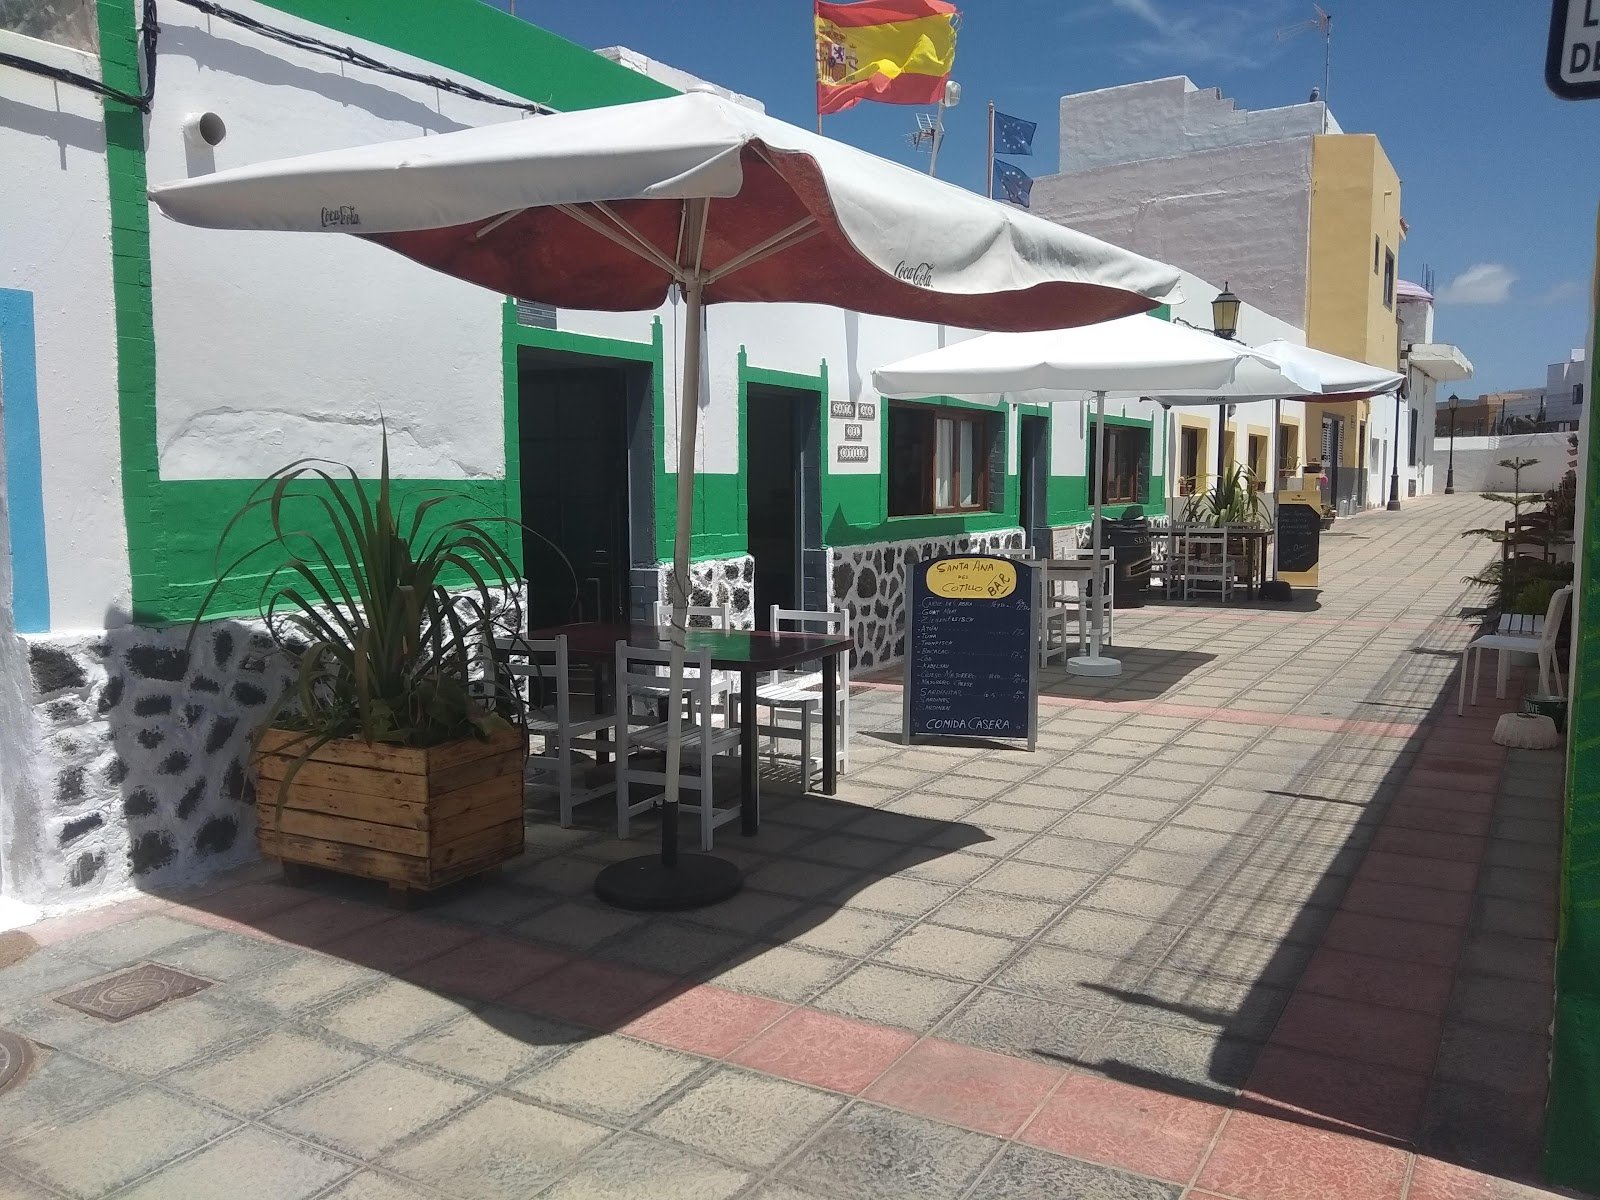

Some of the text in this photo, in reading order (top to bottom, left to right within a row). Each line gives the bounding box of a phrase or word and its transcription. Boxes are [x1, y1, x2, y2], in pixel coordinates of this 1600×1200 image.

[847, 426, 860, 437] DEL
[840, 447, 867, 459] COTILLO
[936, 559, 994, 573] SANTA ANA
[941, 582, 983, 593] COTILLO
[987, 573, 1011, 597] BAR
[926, 717, 1010, 730] COMIDA CASERA
